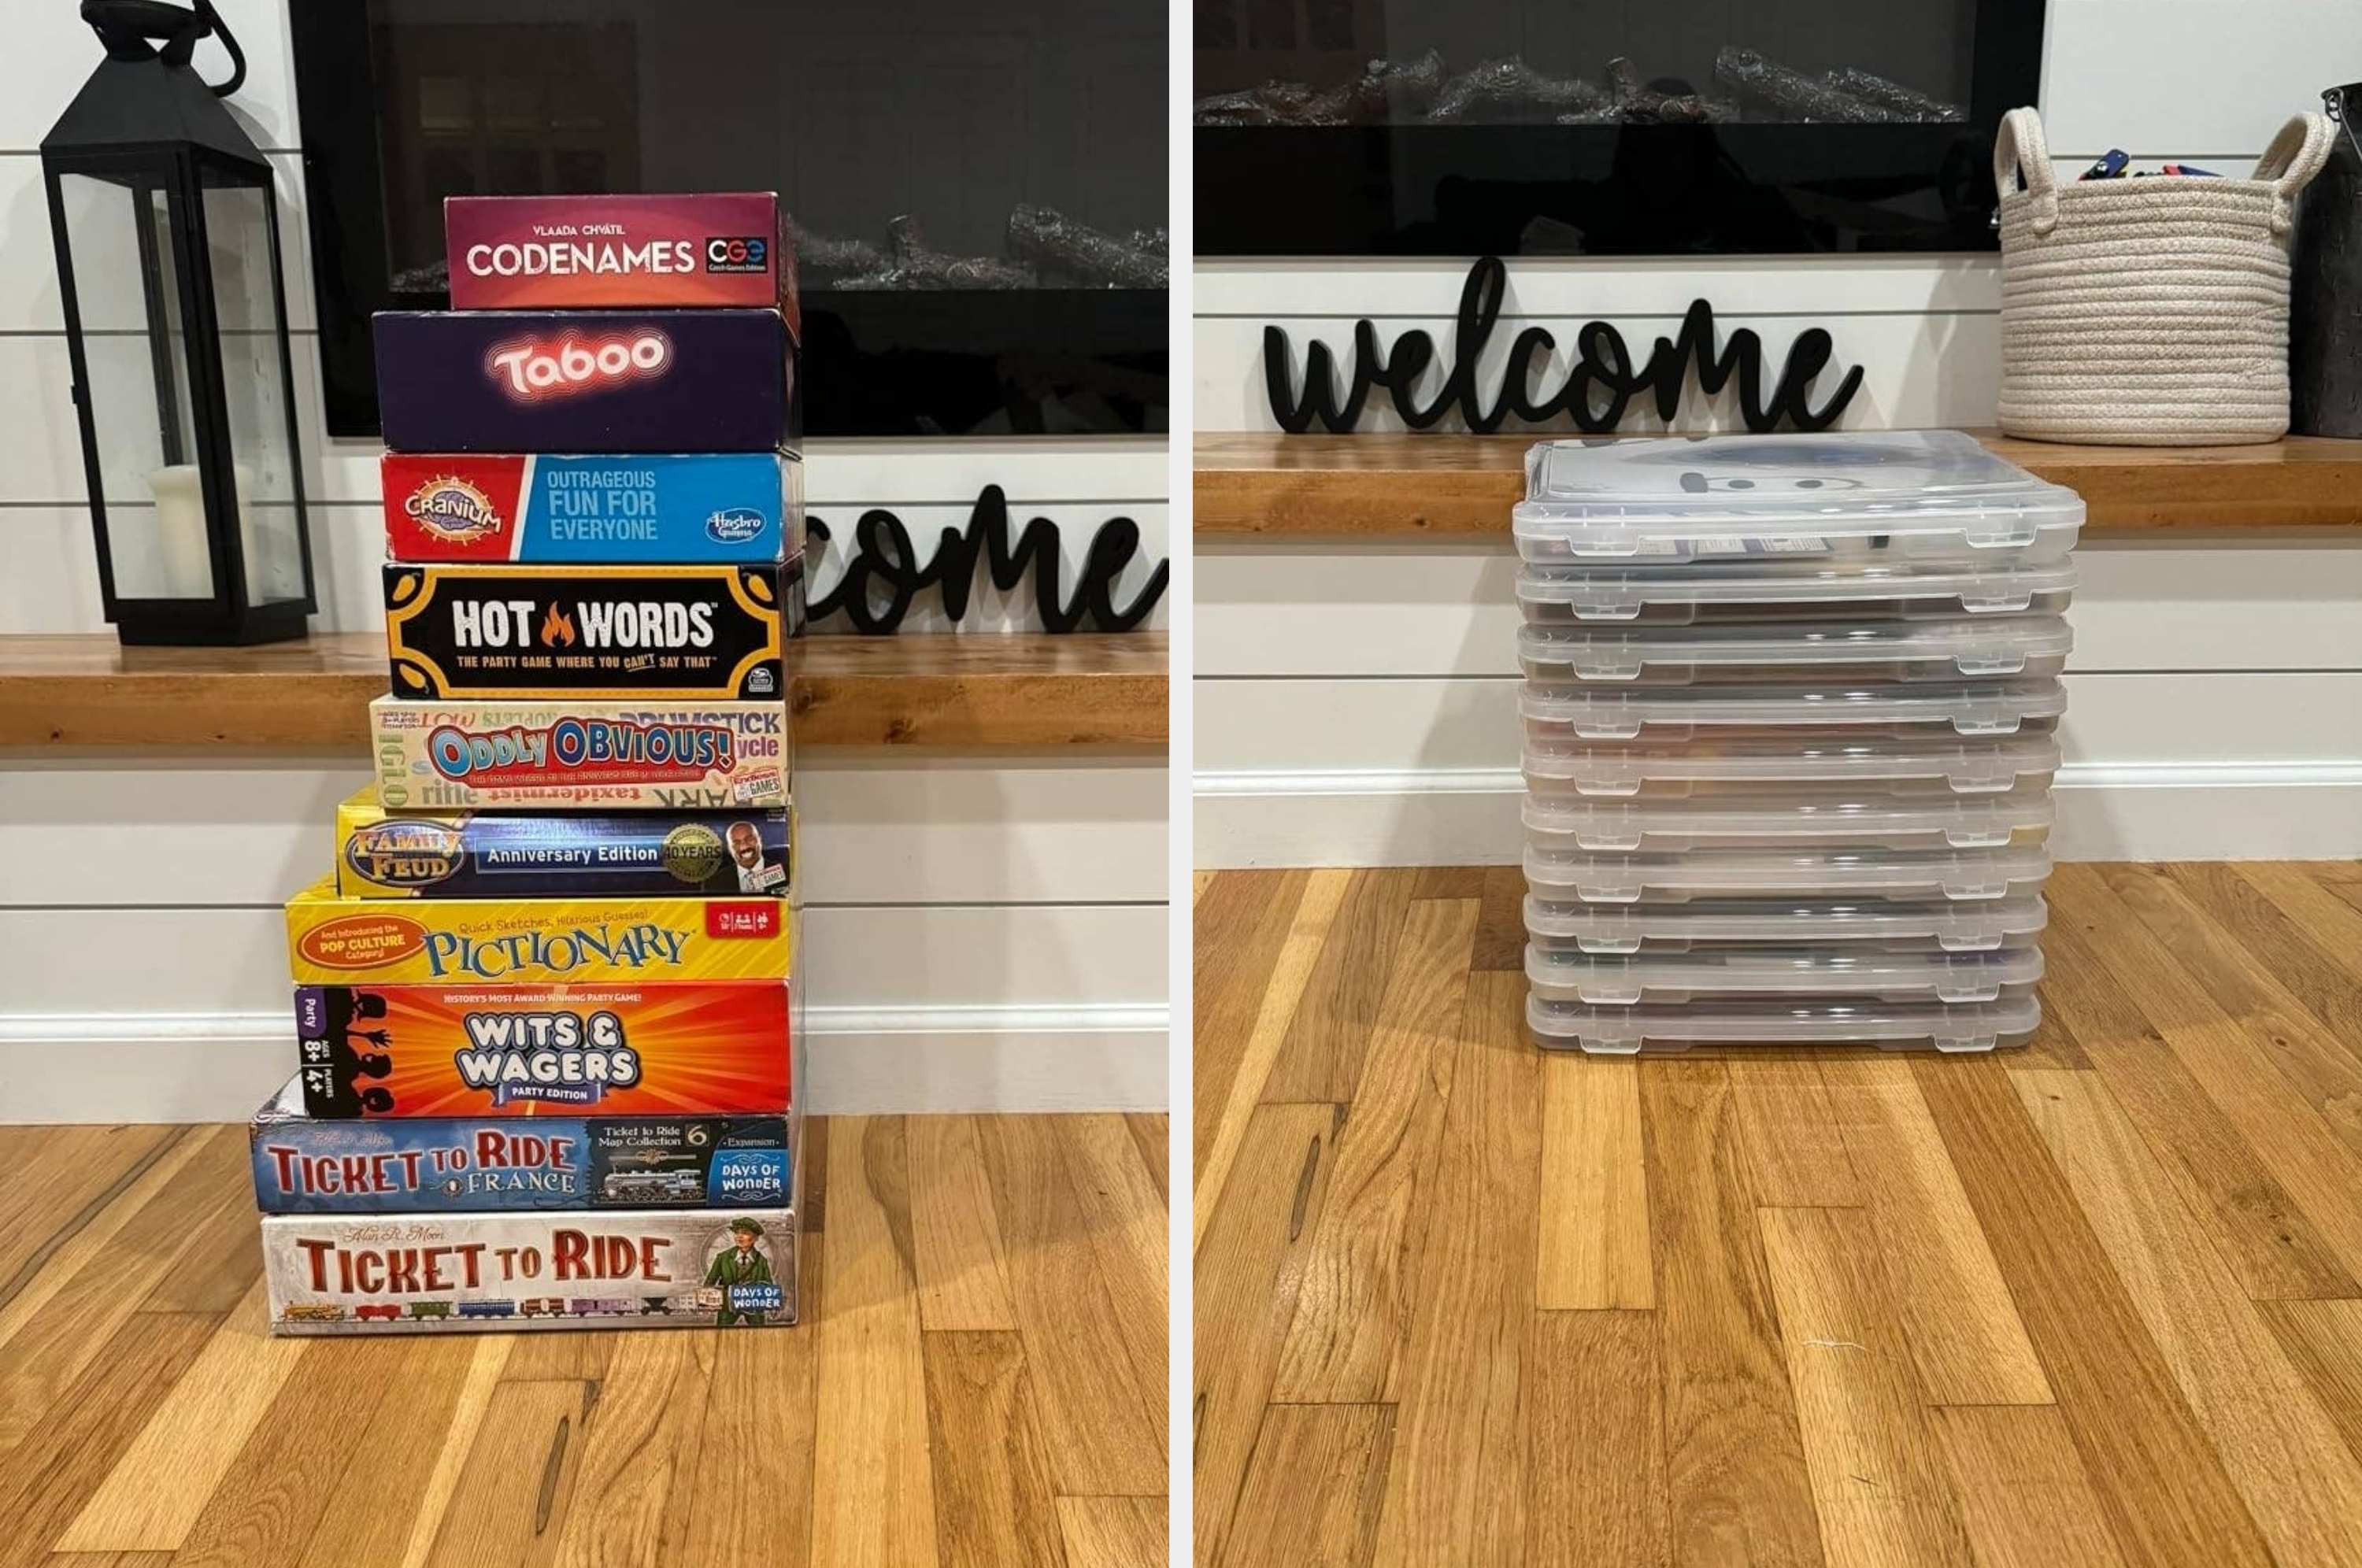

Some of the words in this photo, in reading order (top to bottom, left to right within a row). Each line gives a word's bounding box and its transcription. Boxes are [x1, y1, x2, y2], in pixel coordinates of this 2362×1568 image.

[533, 225, 577, 235] VLAADA
[583, 224, 625, 235] CHVÁTIL
[467, 241, 695, 276] CODENAMES
[1264, 257, 1864, 434] welcome
[494, 336, 665, 394] Taboo
[547, 471, 656, 488] OUTRAGEOUS
[550, 490, 598, 516] FUN
[608, 490, 656, 516] FOR
[551, 519, 658, 541] EVERYONE
[710, 511, 761, 530] Hasbro
[452, 601, 535, 647] HOT
[457, 656, 478, 668] THE
[483, 656, 516, 668] PARTY
[522, 656, 551, 668] GAME
[556, 656, 594, 668] WHERE
[599, 656, 620, 668] YOU
[659, 656, 679, 668] SAY
[432, 729, 548, 777] ODDLY
[553, 719, 733, 768] OBVIOUS!
[488, 787, 642, 801] taxidermist
[750, 778, 779, 794] GAMES
[354, 831, 464, 857] FAMILY
[683, 845, 721, 859] YEARS
[487, 847, 591, 865] Anniversary
[598, 845, 657, 861] Edition
[371, 852, 450, 880] FEUD
[339, 926, 383, 938] Introducing
[385, 924, 398, 934] the
[459, 923, 492, 934] Quick
[557, 914, 601, 925] Hilarious
[603, 910, 648, 922] Guesses!
[320, 941, 346, 954] POP
[349, 934, 405, 950] CULTURE
[423, 923, 690, 978] PICTIONARY
[444, 994, 487, 1004] HISTORY'S
[489, 994, 512, 1003] MOST
[587, 993, 613, 1002] PARTY
[615, 993, 642, 1002] GAME!
[305, 998, 317, 1028] Party
[469, 1015, 578, 1048] WITS
[592, 1016, 618, 1047] &
[305, 1041, 322, 1063] 8+
[460, 1051, 635, 1082] WAGERS
[306, 1070, 324, 1093] 4+
[512, 1087, 544, 1097] PARTY
[546, 1088, 588, 1100] EDITION
[604, 1126, 639, 1136] Ticket
[642, 1126, 653, 1136] to
[657, 1126, 680, 1136] Ride
[687, 1125, 708, 1145] 6
[598, 1137, 624, 1147] Map
[627, 1137, 681, 1146] Collection
[727, 1137, 776, 1147] Expansion
[267, 1145, 423, 1195] TICKET
[430, 1147, 468, 1172] TO
[476, 1128, 576, 1171] RIDE
[723, 1164, 757, 1176] DAYS
[761, 1164, 780, 1175] OF
[466, 1171, 576, 1194] FRANCE
[723, 1178, 781, 1191] WONDER
[343, 1227, 379, 1243] Alan
[296, 1238, 487, 1294] TICKET
[494, 1246, 542, 1281] TO
[552, 1228, 674, 1282] RIDE
[734, 1288, 761, 1297] DAYS
[764, 1287, 780, 1296] OF
[734, 1298, 781, 1308] WONDER
